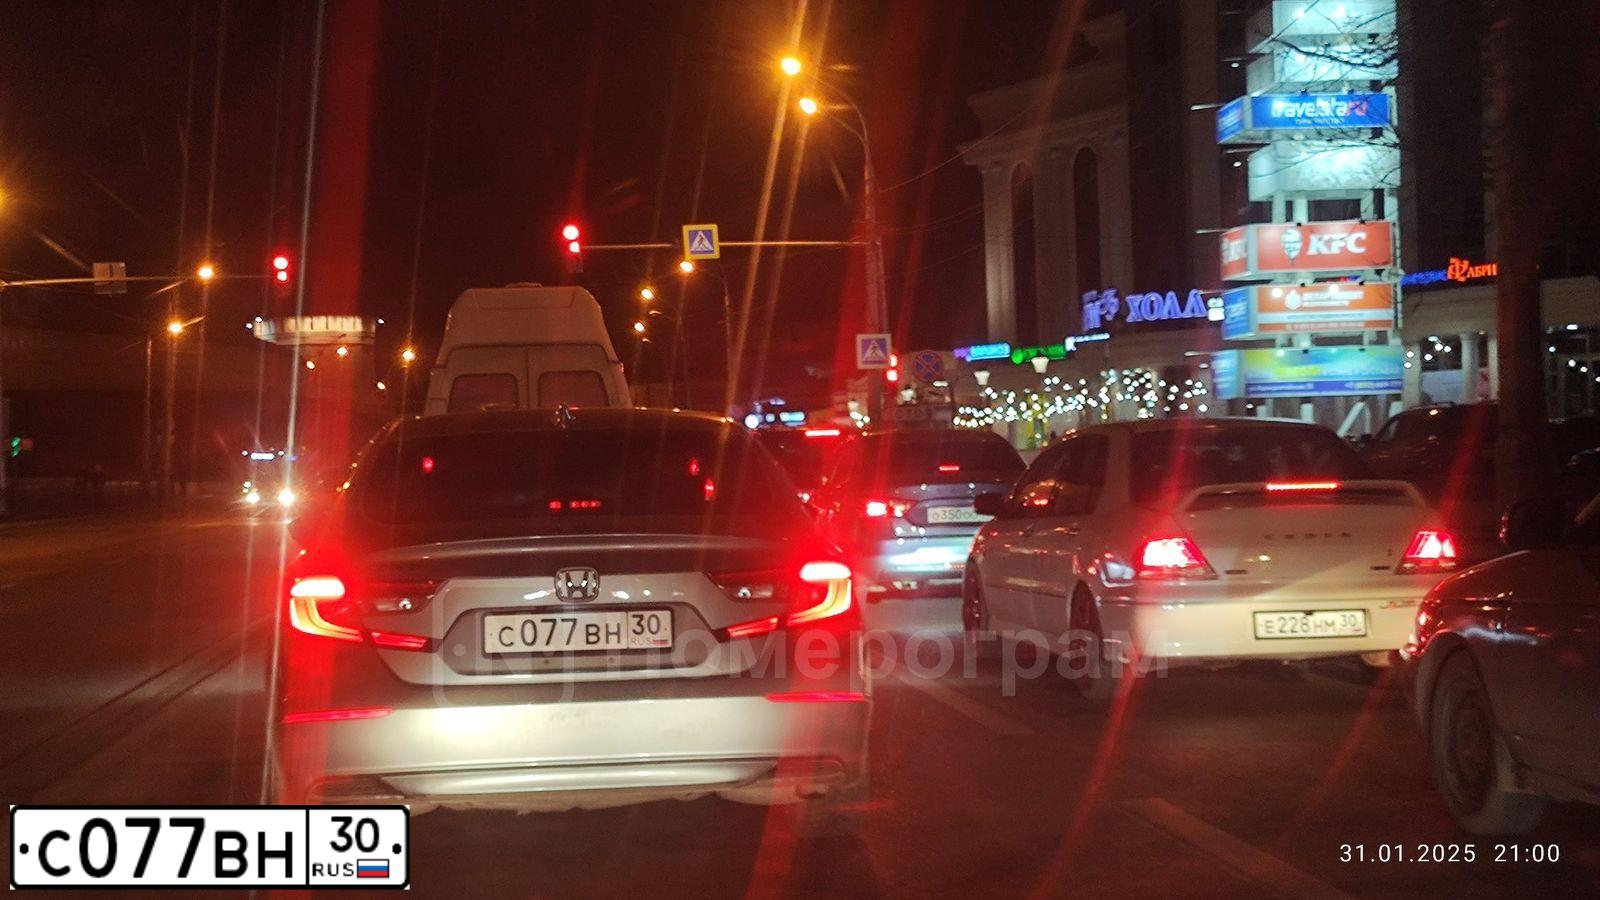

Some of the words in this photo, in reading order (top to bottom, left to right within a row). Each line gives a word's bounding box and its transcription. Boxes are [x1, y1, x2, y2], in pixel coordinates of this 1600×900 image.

[1307, 232, 1367, 256] KFC
[498, 618, 622, 647] С077ВН
[632, 614, 660, 635] 30
[1265, 616, 1335, 634] Е228НМ
[1340, 614, 1358, 628] 30
